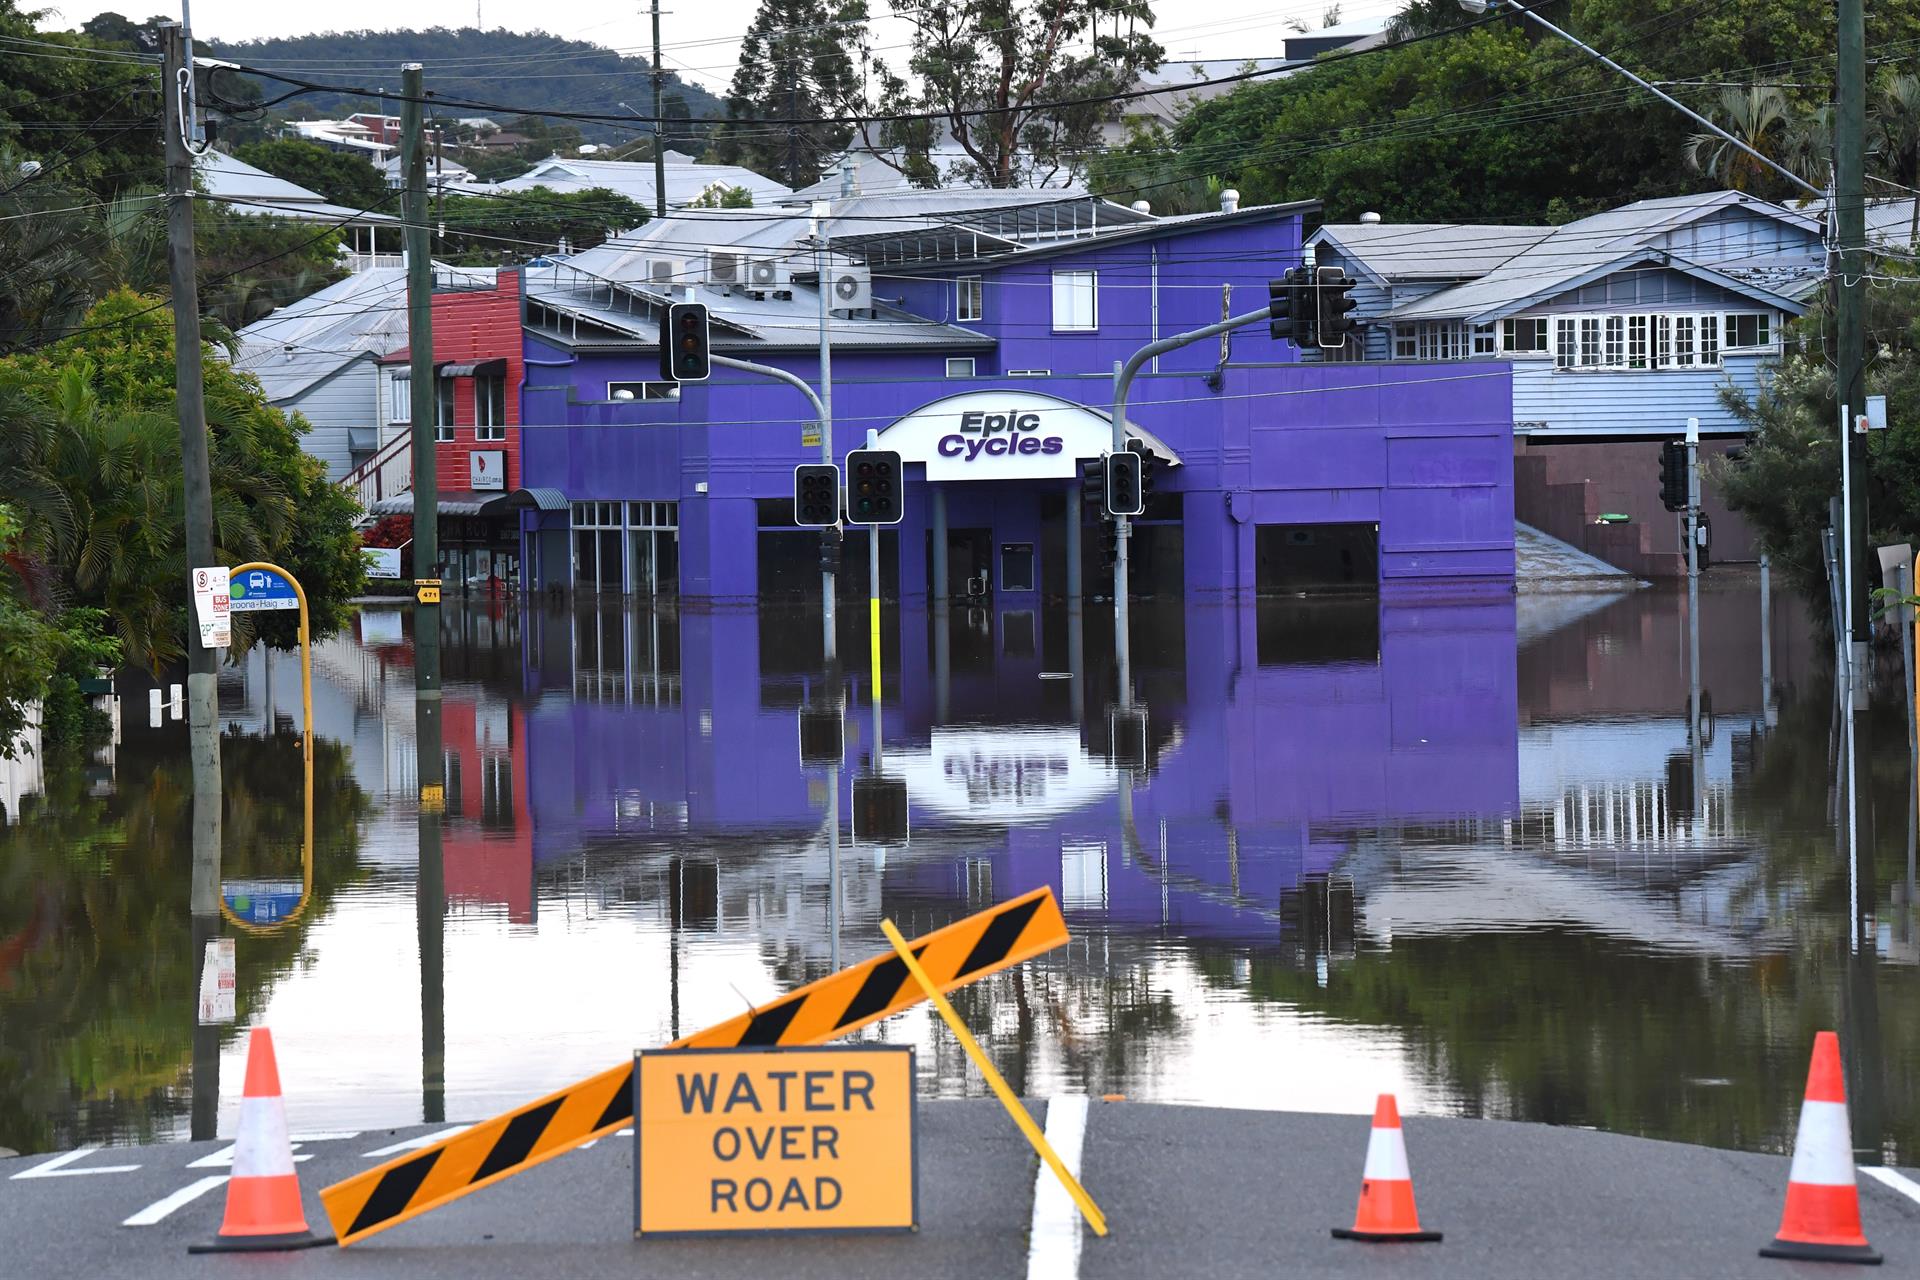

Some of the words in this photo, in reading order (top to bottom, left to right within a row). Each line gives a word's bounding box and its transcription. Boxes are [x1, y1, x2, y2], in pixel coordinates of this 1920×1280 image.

[960, 409, 1040, 438] Epic
[937, 432, 1063, 462] Cycles
[215, 596, 227, 604] BUS
[230, 599, 278, 609] aroona-Haig
[200, 624, 211, 637] 2P
[676, 1070, 875, 1114] WATER
[712, 1125, 839, 1161] OVER
[711, 1176, 843, 1213] ROAD
